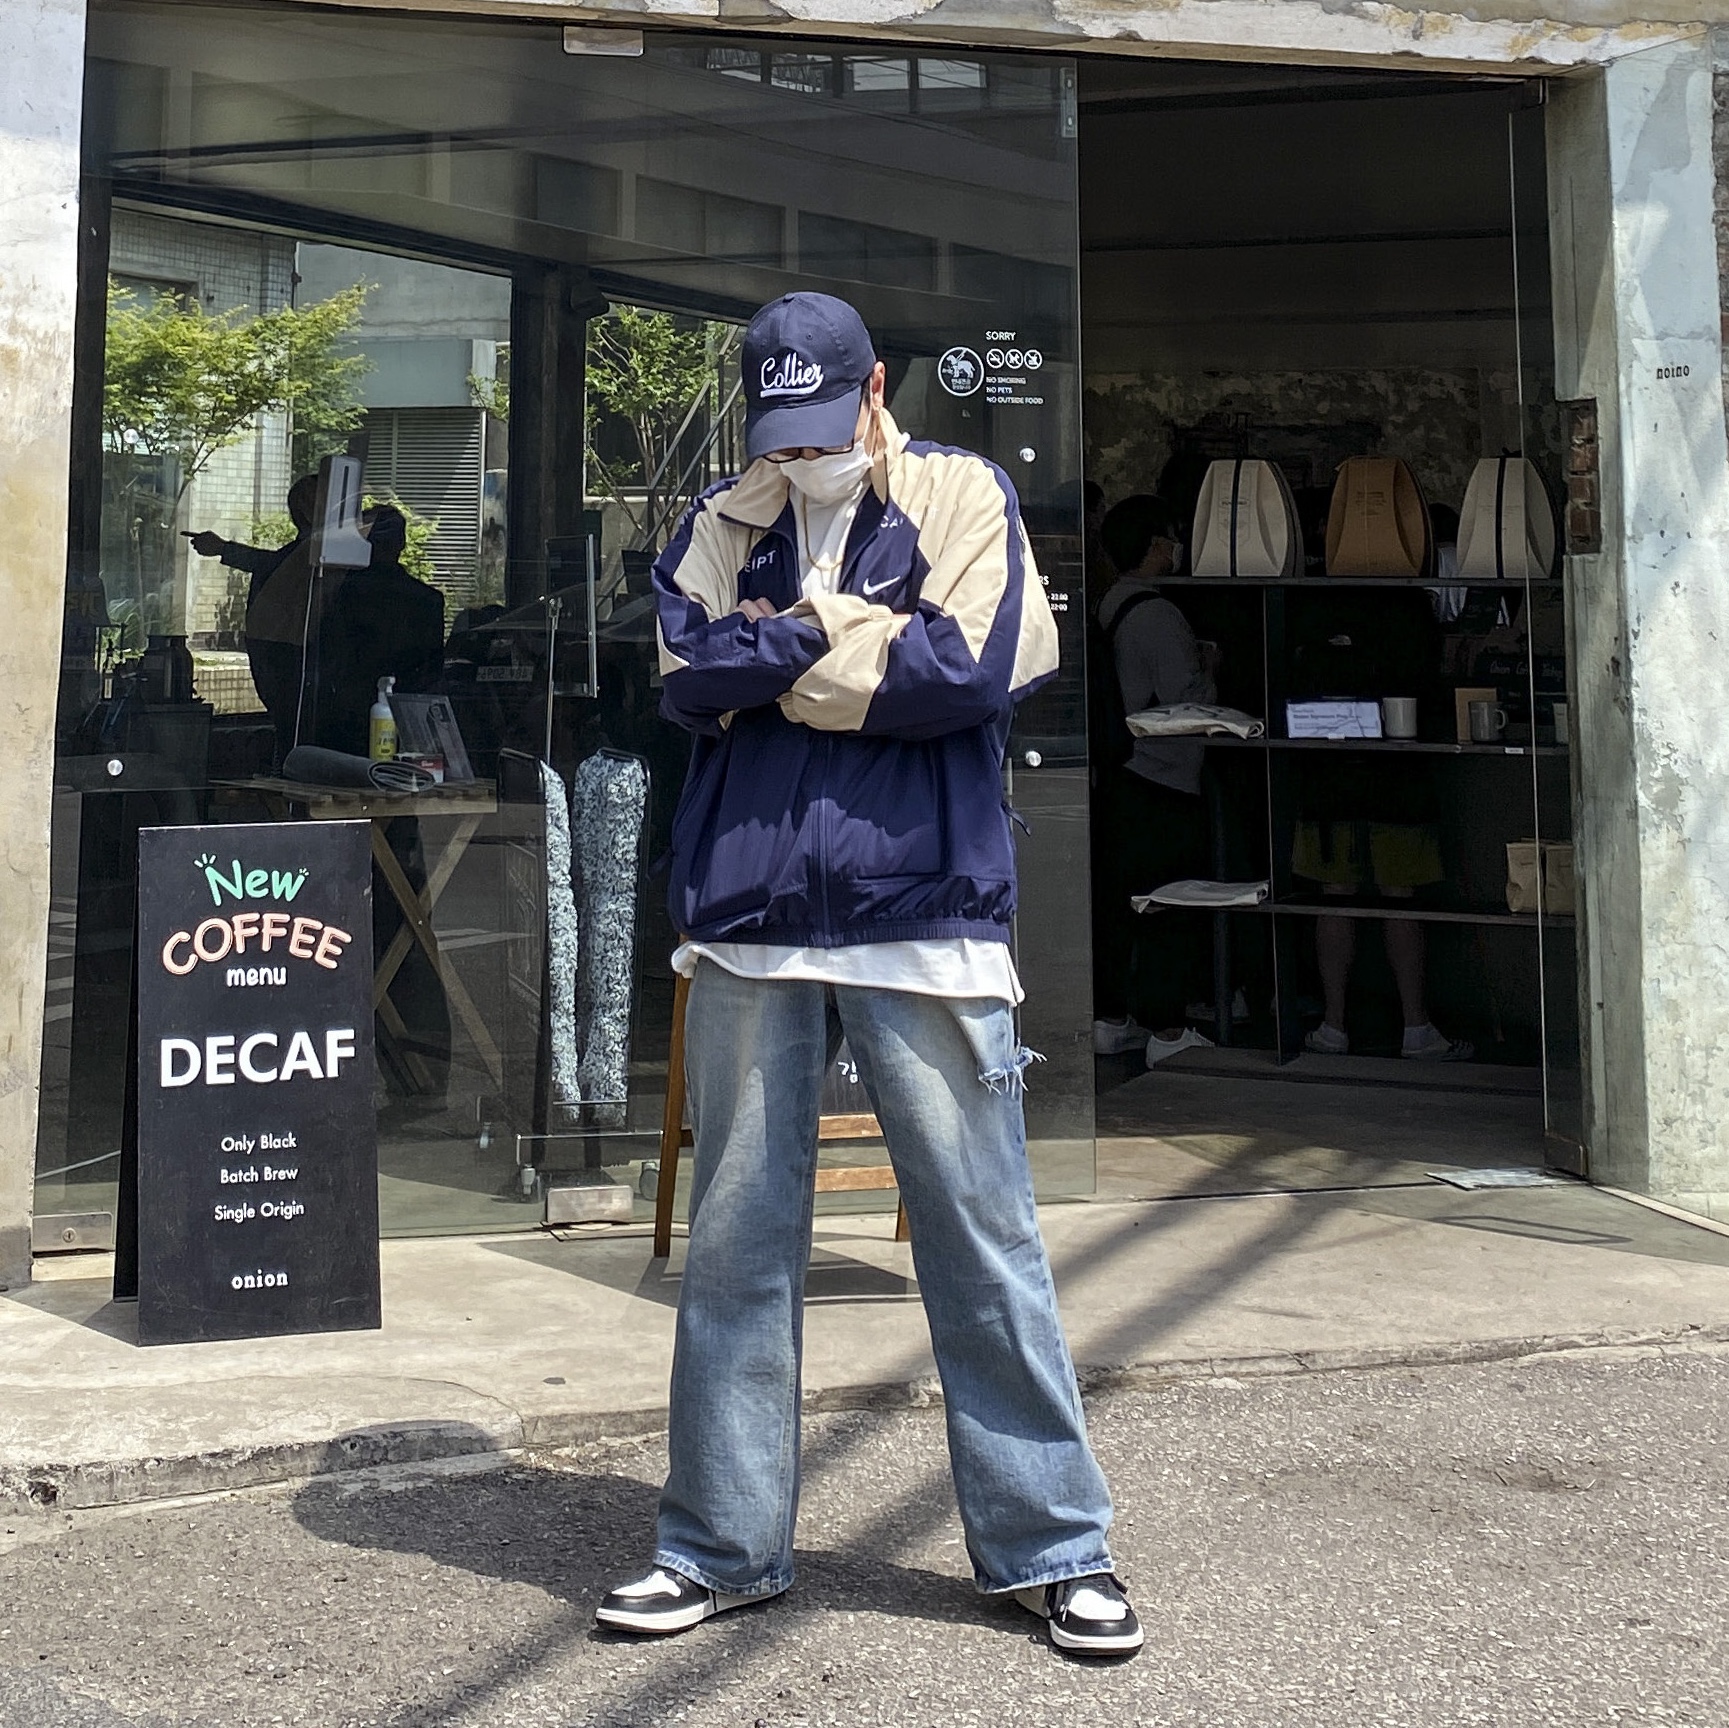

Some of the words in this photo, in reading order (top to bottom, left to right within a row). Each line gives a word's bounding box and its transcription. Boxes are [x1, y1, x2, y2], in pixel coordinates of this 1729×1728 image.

[985, 330, 1017, 341] SORRY
[760, 352, 824, 389] Collier
[986, 376, 997, 385] NO
[1656, 365, 1690, 380] noino
[986, 386, 997, 394] NO
[997, 386, 1013, 395] PETS
[986, 396, 997, 404] NO
[1025, 397, 1044, 405] FOOD
[205, 859, 305, 906] New
[162, 912, 352, 975] COFFEE
[226, 966, 287, 988] menu
[160, 1028, 355, 1088] DECAF
[220, 1134, 256, 1154] Only
[260, 1131, 297, 1150] Black
[220, 1165, 259, 1184] Batch
[263, 1165, 299, 1181] Brew
[214, 1202, 256, 1223] Single
[260, 1199, 305, 1220] Origin
[230, 1268, 289, 1290] onion
